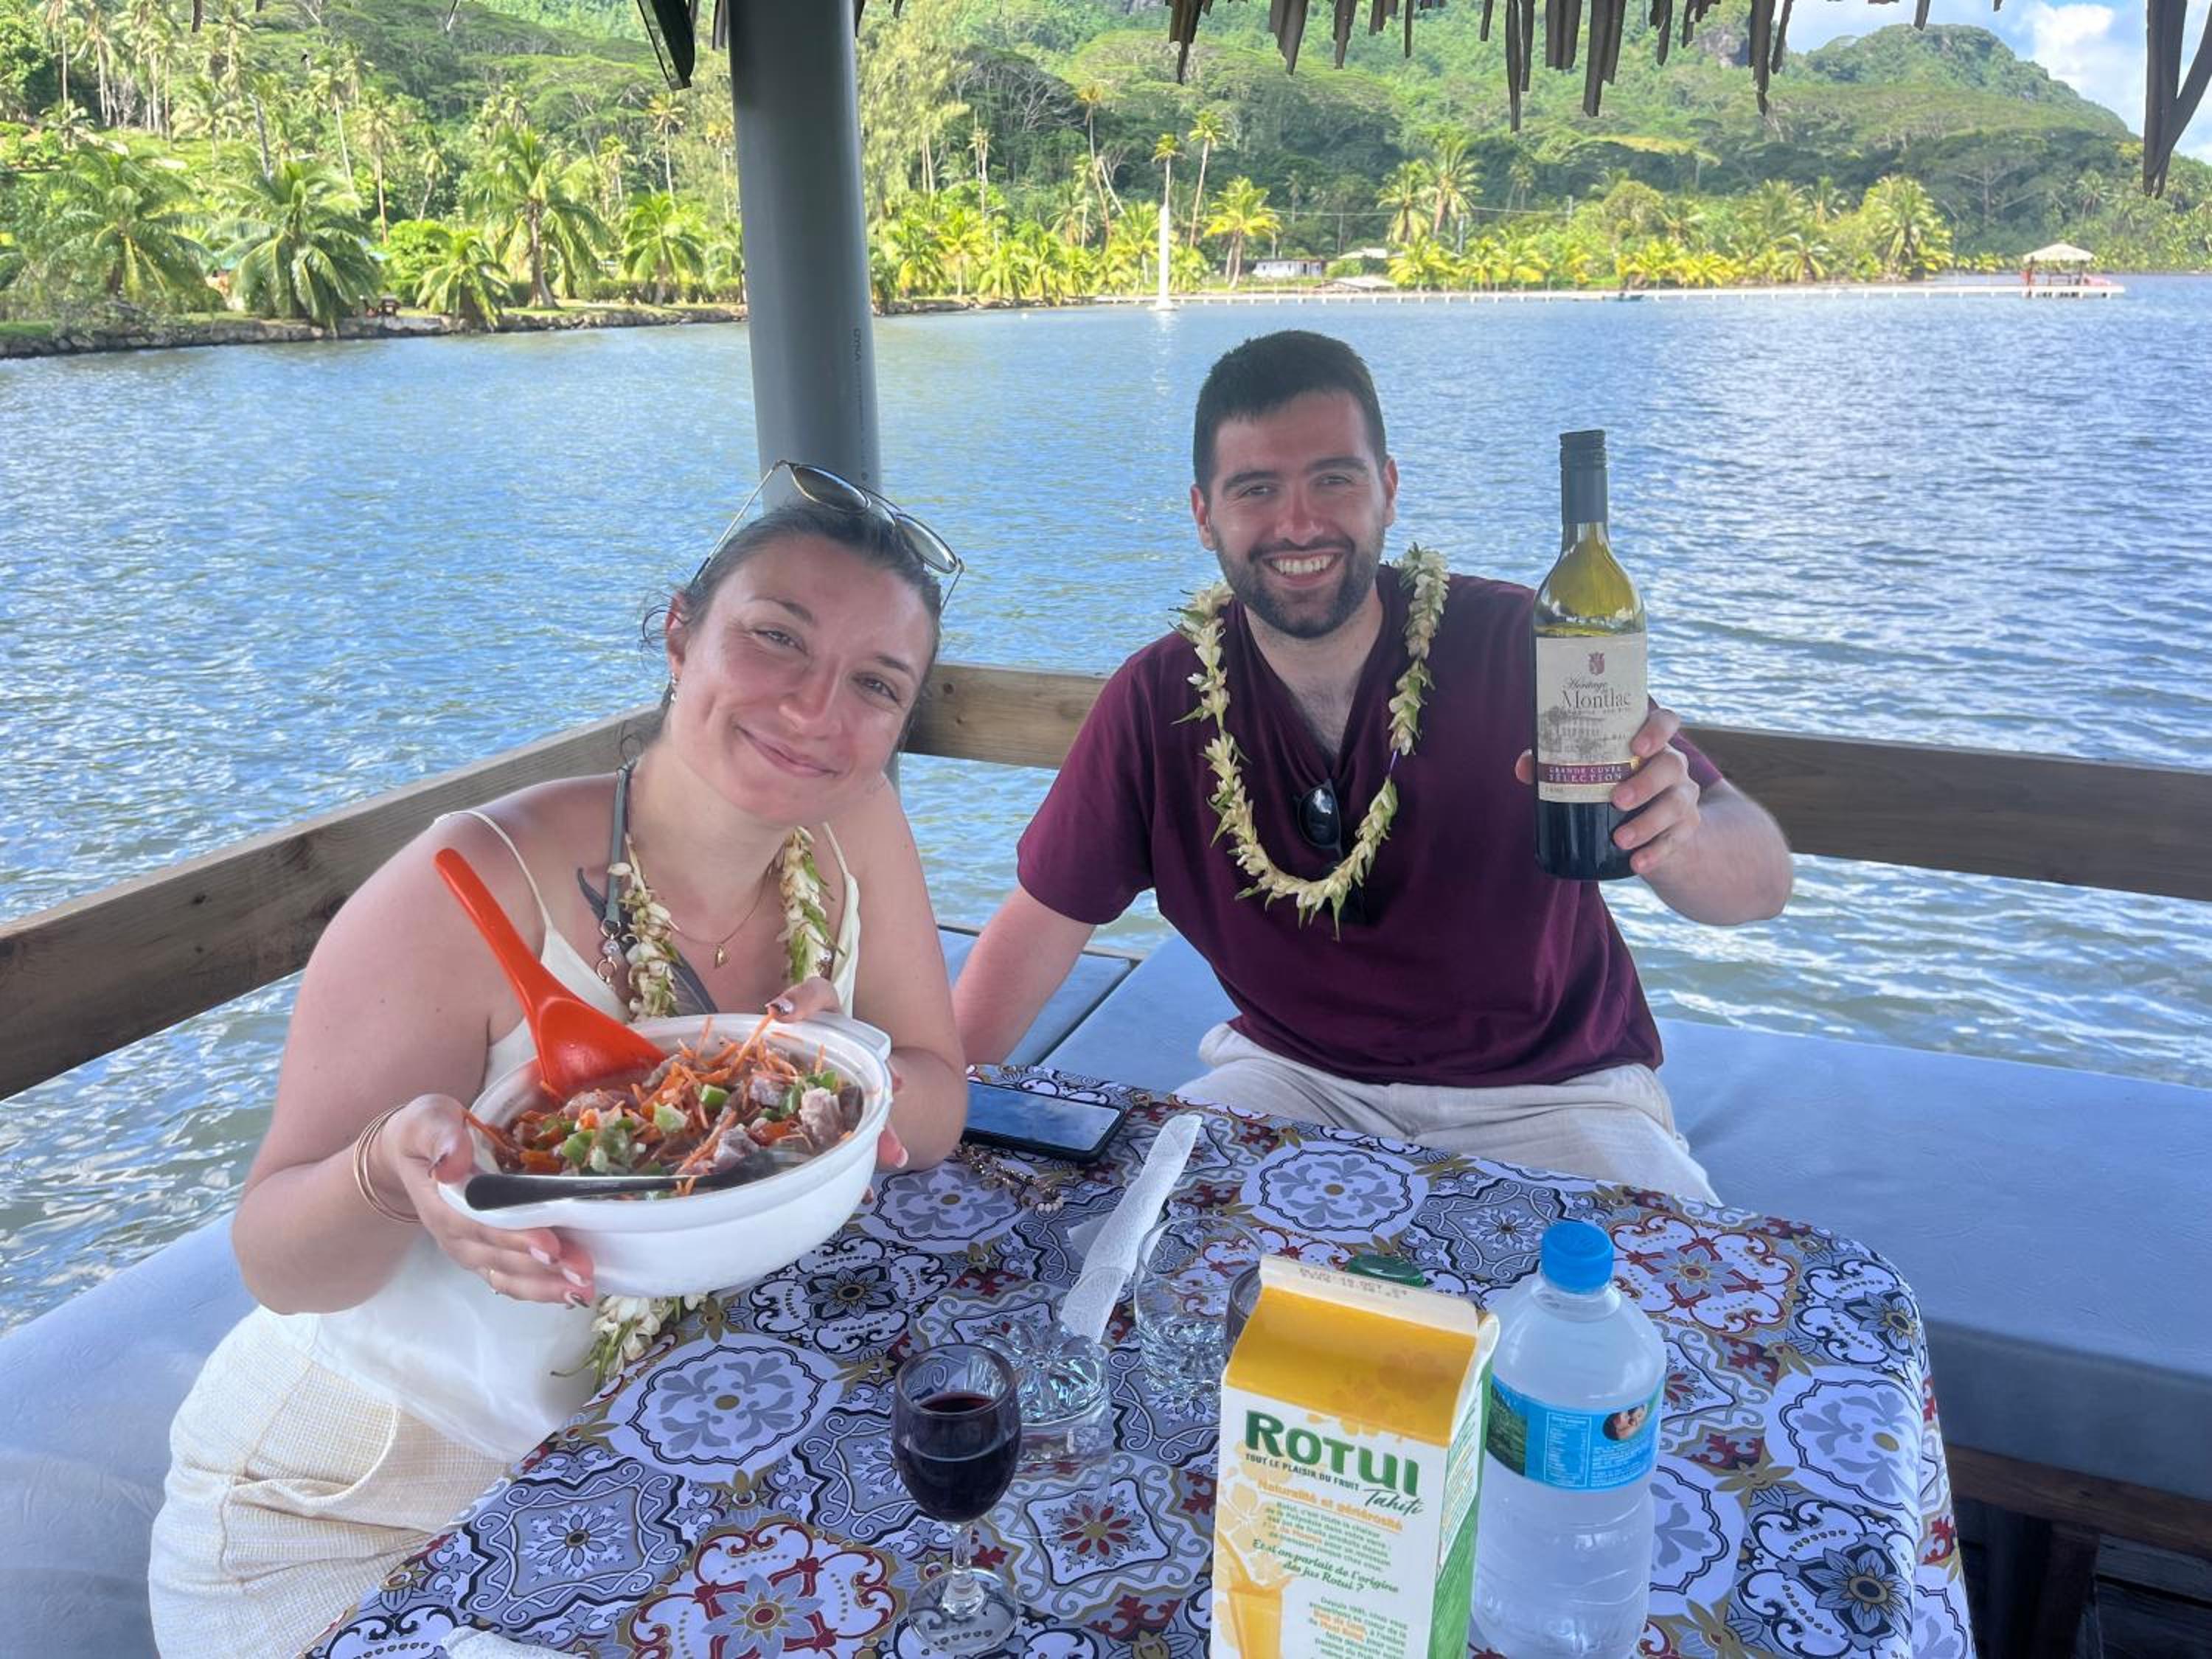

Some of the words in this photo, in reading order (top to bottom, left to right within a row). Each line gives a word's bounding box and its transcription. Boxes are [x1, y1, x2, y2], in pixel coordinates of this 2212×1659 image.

[1245, 1409, 1419, 1497] ROTUI
[1245, 1453, 1267, 1465] TOUT
[1269, 1456, 1279, 1468] LE
[1282, 1460, 1317, 1480] PLAISIR
[1319, 1472, 1332, 1483] DU
[1334, 1477, 1360, 1492] FRUIT
[1363, 1487, 1425, 1517] Tahiti
[1292, 1552, 1335, 1573] parlait
[1335, 1563, 1349, 1577] de
[1351, 1570, 1399, 1594] l'origine
[1321, 1572, 1353, 1591] Rotui
